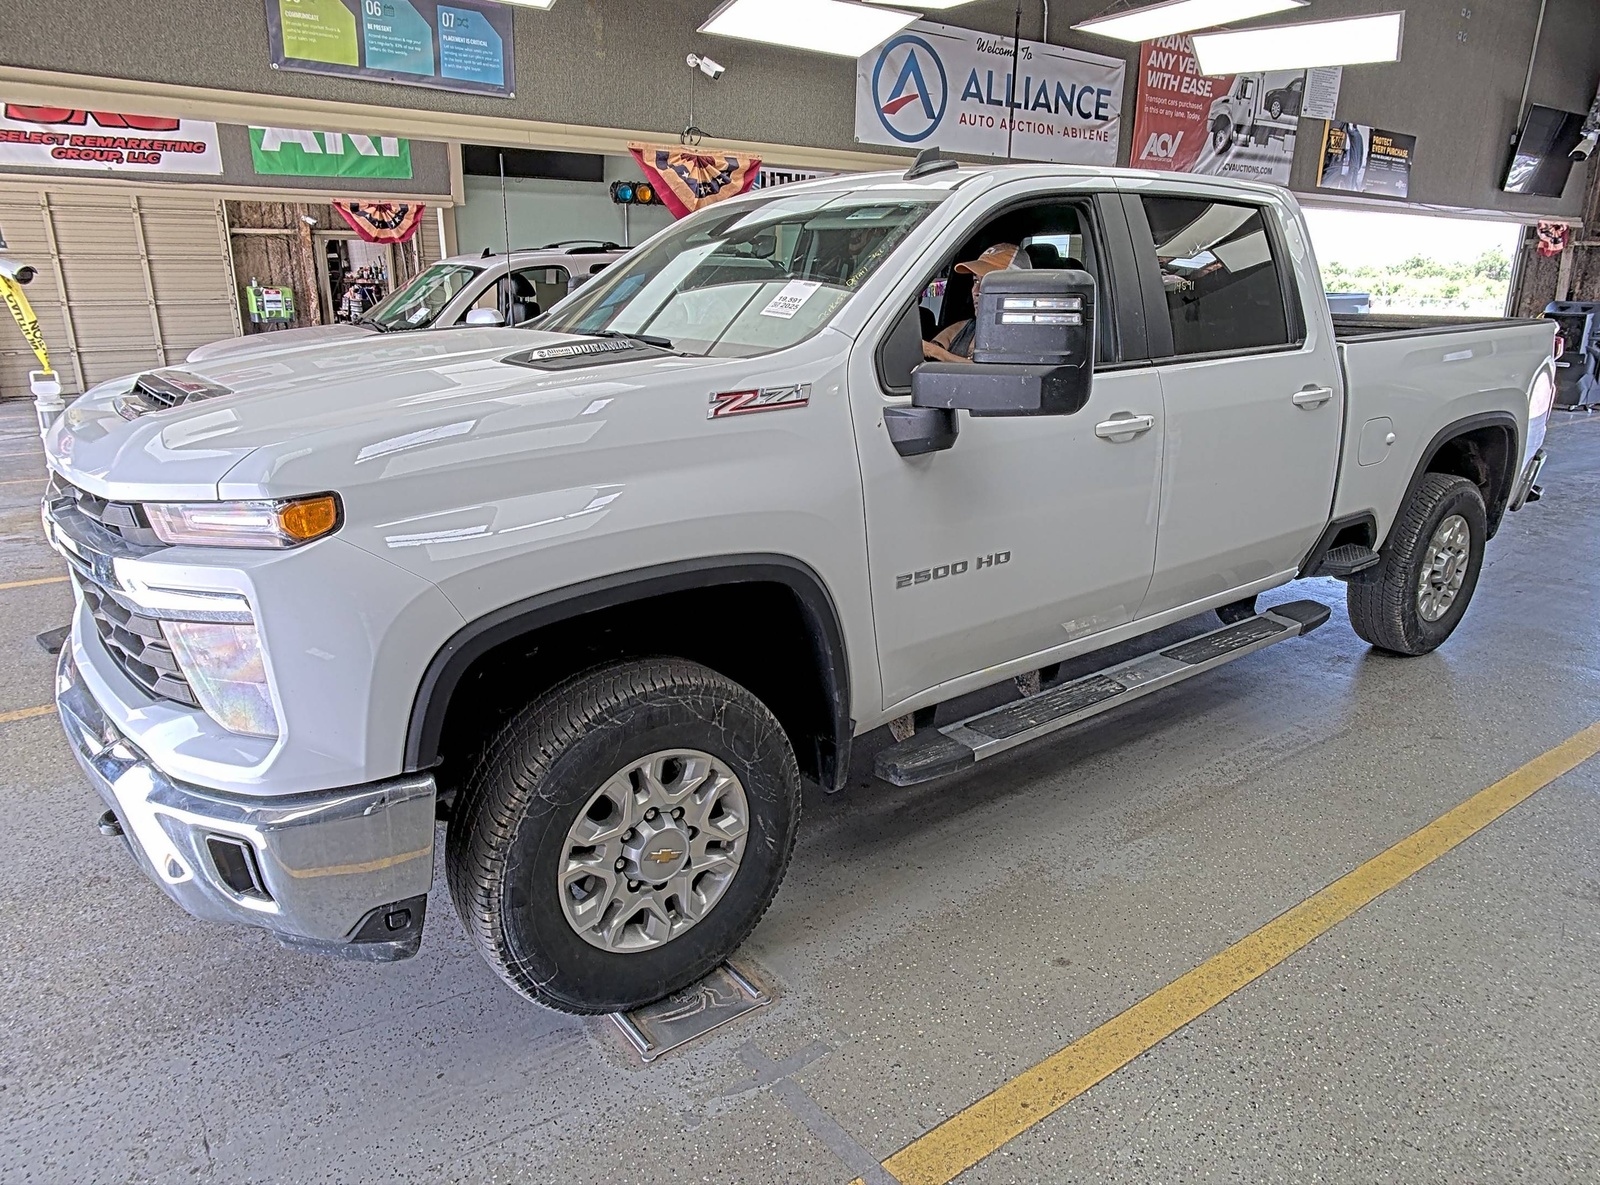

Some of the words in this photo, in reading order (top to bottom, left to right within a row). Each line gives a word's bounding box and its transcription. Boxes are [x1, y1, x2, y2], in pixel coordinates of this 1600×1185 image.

[366, 0, 382, 16] 06
[442, 12, 454, 28] 07
[442, 34, 465, 44] PLACEMENT
[1151, 34, 1196, 54] TRANS
[1021, 46, 1033, 60] To
[1147, 50, 1177, 70] ANY
[1147, 70, 1180, 92] WITH
[1180, 76, 1213, 98] EASE.
[960, 67, 1112, 121] ALLIANCE
[1145, 94, 1168, 106] Transport
[1168, 99, 1178, 107] cars
[1178, 100, 1203, 111] purchased
[1144, 104, 1150, 112] in
[1150, 105, 1158, 114] this
[1159, 107, 1165, 115] or
[1165, 108, 1174, 118] any
[1174, 108, 1186, 118] lane.
[959, 112, 994, 128] AUTO
[1000, 118, 1054, 136] AUCTION
[1062, 127, 1109, 142] ABILENE
[0, 130, 69, 146] SELECT
[69, 134, 206, 153] REMARKETING
[1140, 131, 1185, 160] ACV
[1372, 135, 1393, 146] PROTECT
[52, 147, 124, 164] GROUP,
[126, 152, 161, 164] LLC
[1371, 144, 1387, 155] EVERY
[780, 302, 799, 310] 2025
[571, 340, 634, 355] DURAMAX
[707, 383, 812, 420] Z71
[895, 560, 968, 590] 2500
[976, 551, 1011, 570] HD
